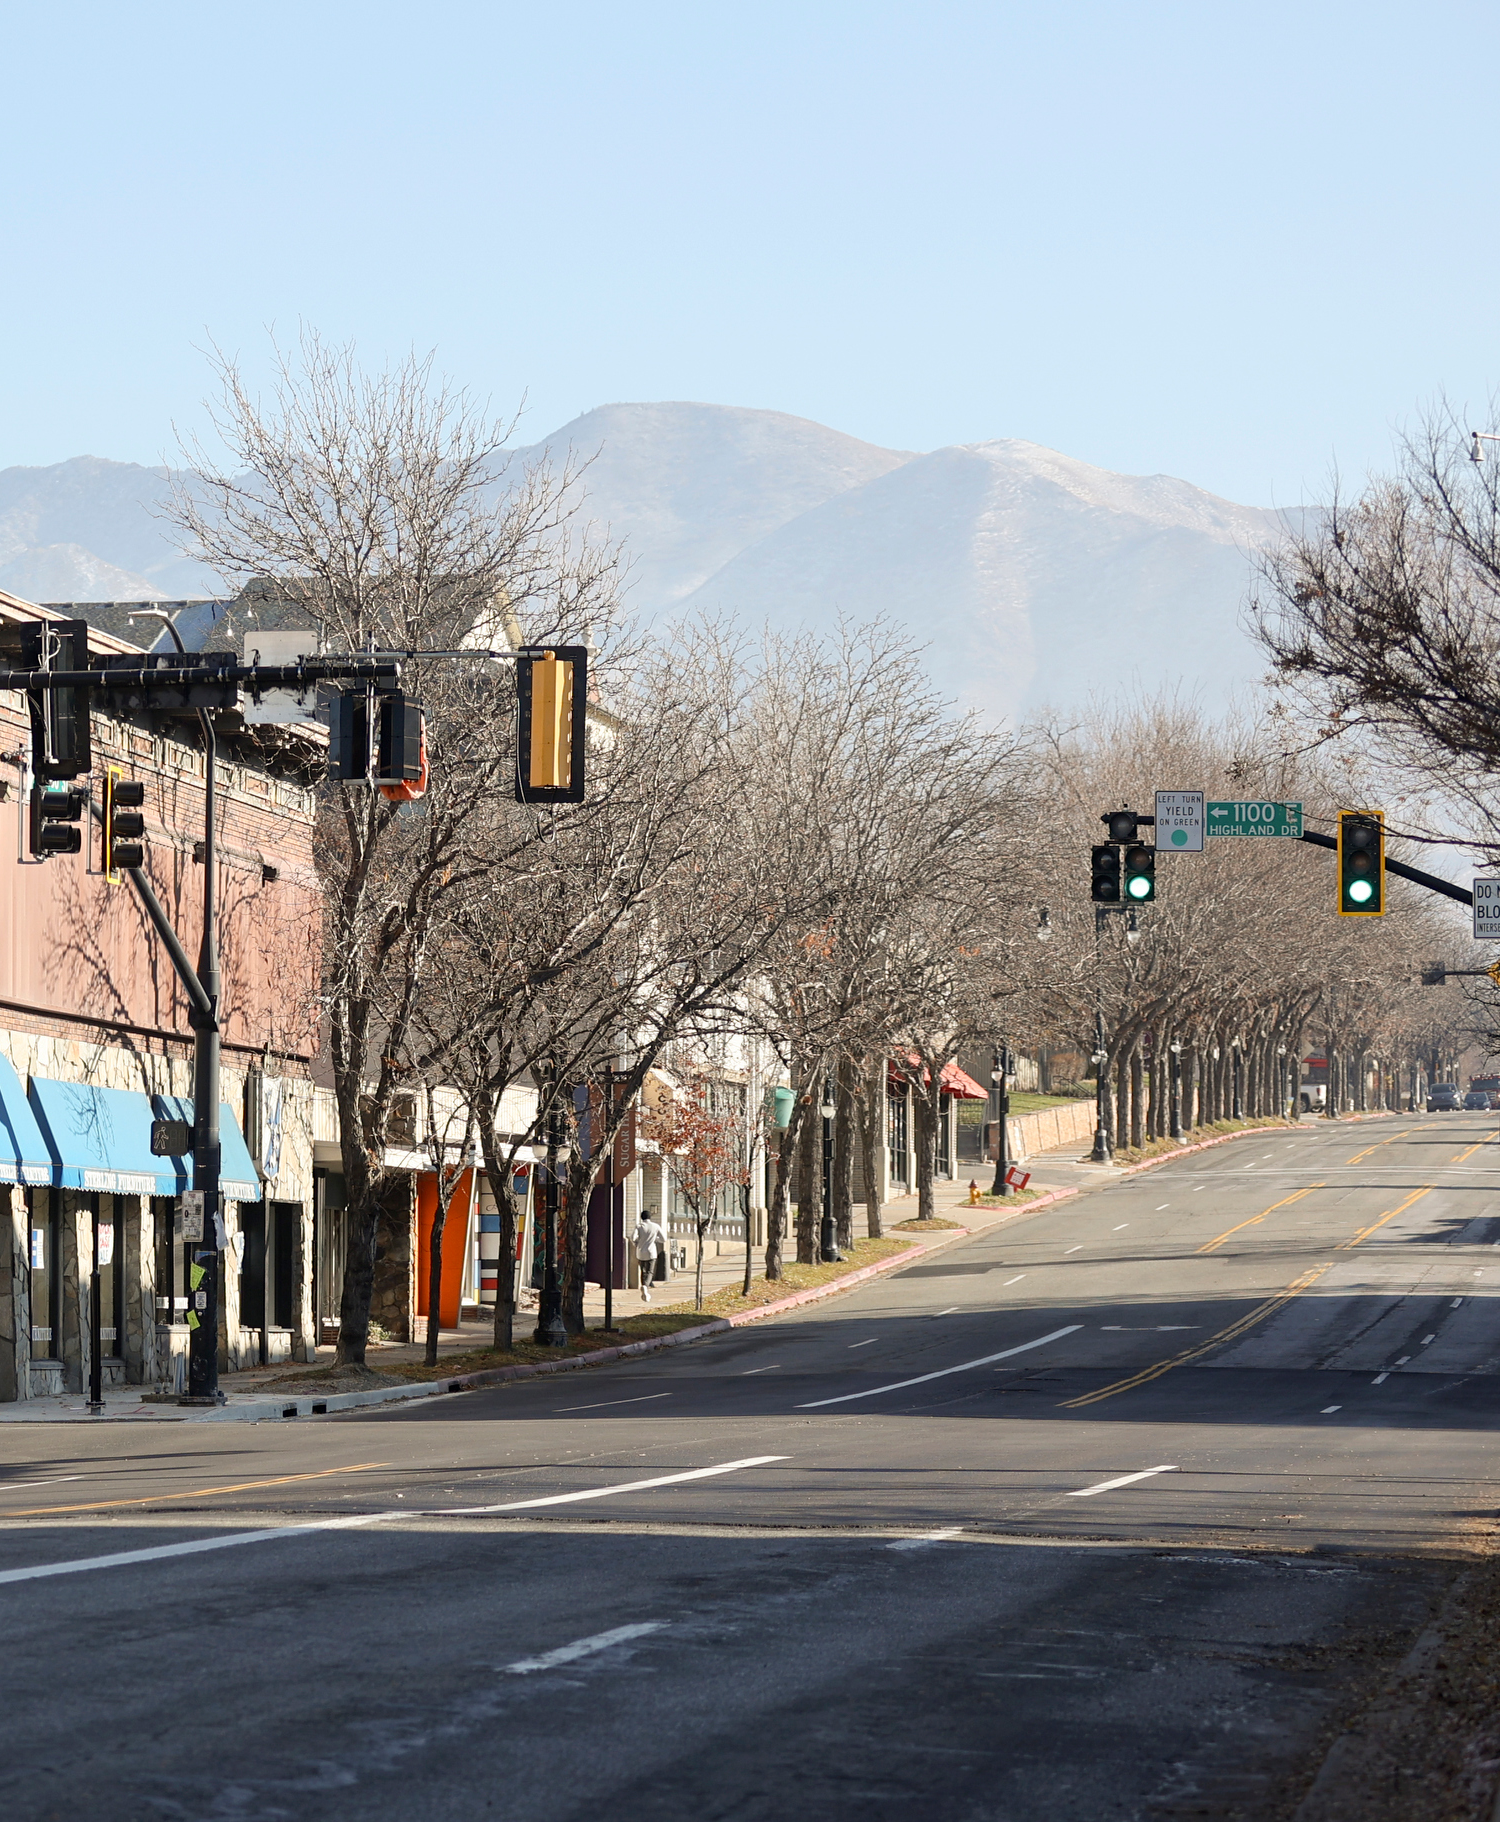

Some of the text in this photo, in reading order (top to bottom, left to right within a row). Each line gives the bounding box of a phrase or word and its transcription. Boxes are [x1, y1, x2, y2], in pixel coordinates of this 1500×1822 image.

[1158, 795, 1200, 803] LEFT TURN
[1165, 806, 1194, 816] YIELD
[1233, 803, 1298, 823] 1100 E
[1159, 818, 1200, 826] ON GREEN
[1209, 825, 1298, 835] HIGHLAND DR
[1477, 885, 1492, 898] DO
[620, 1130, 630, 1167] SUGAR
